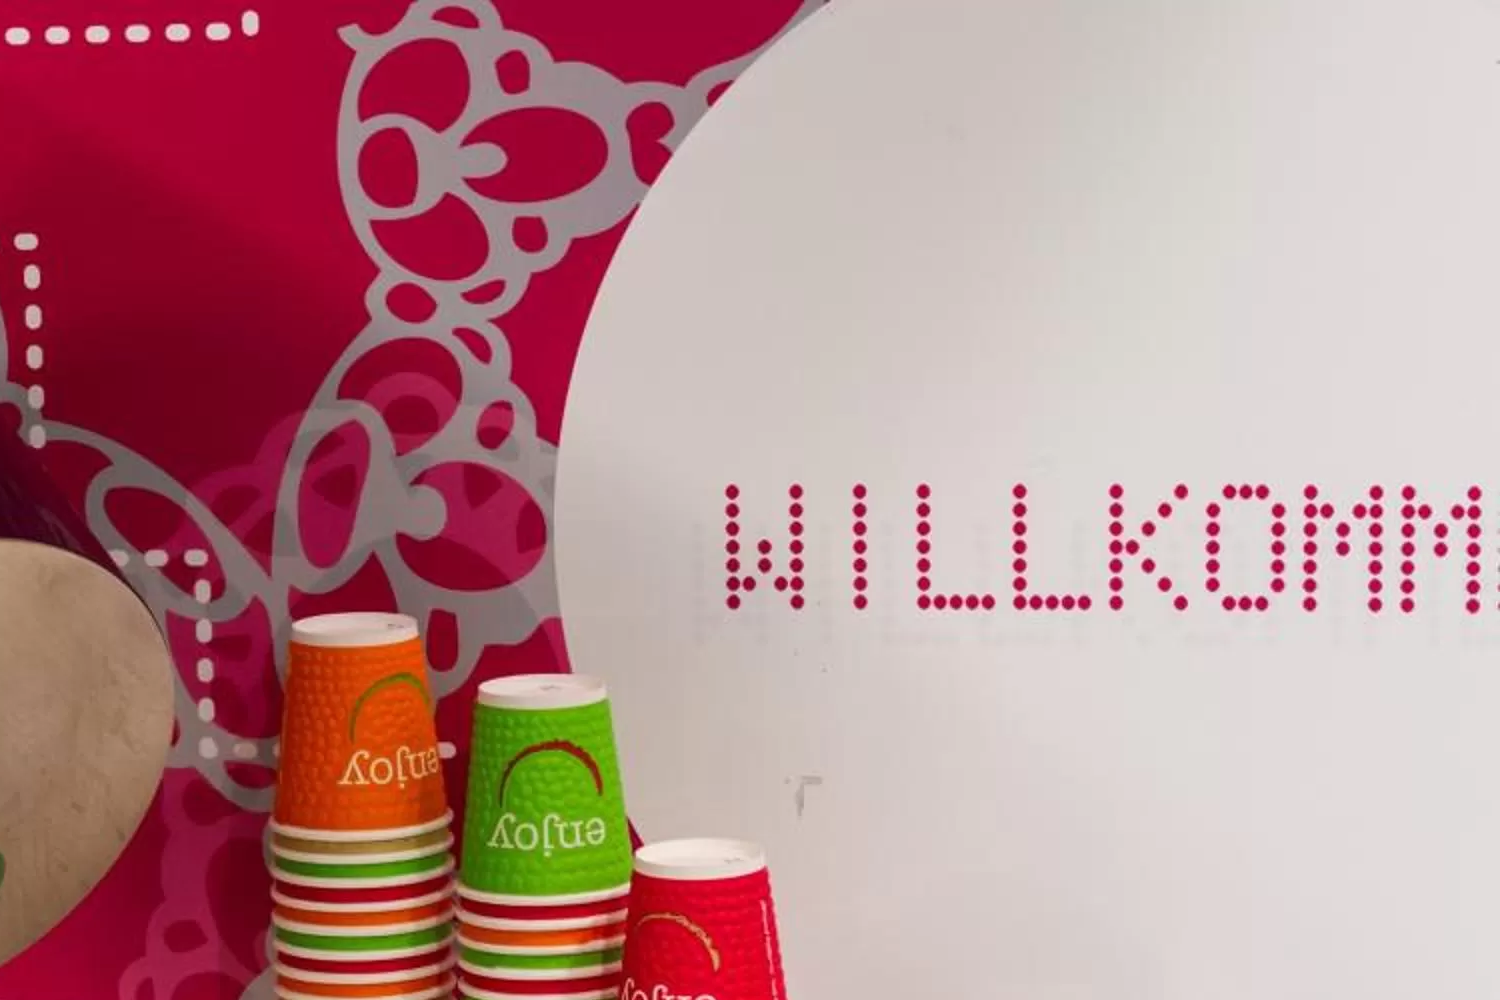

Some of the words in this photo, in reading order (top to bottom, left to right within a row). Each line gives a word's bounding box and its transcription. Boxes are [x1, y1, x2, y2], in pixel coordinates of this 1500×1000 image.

[724, 484, 1500, 613] WILLKOMM
[337, 745, 439, 789] enjoy
[486, 812, 607, 857] enjoy
